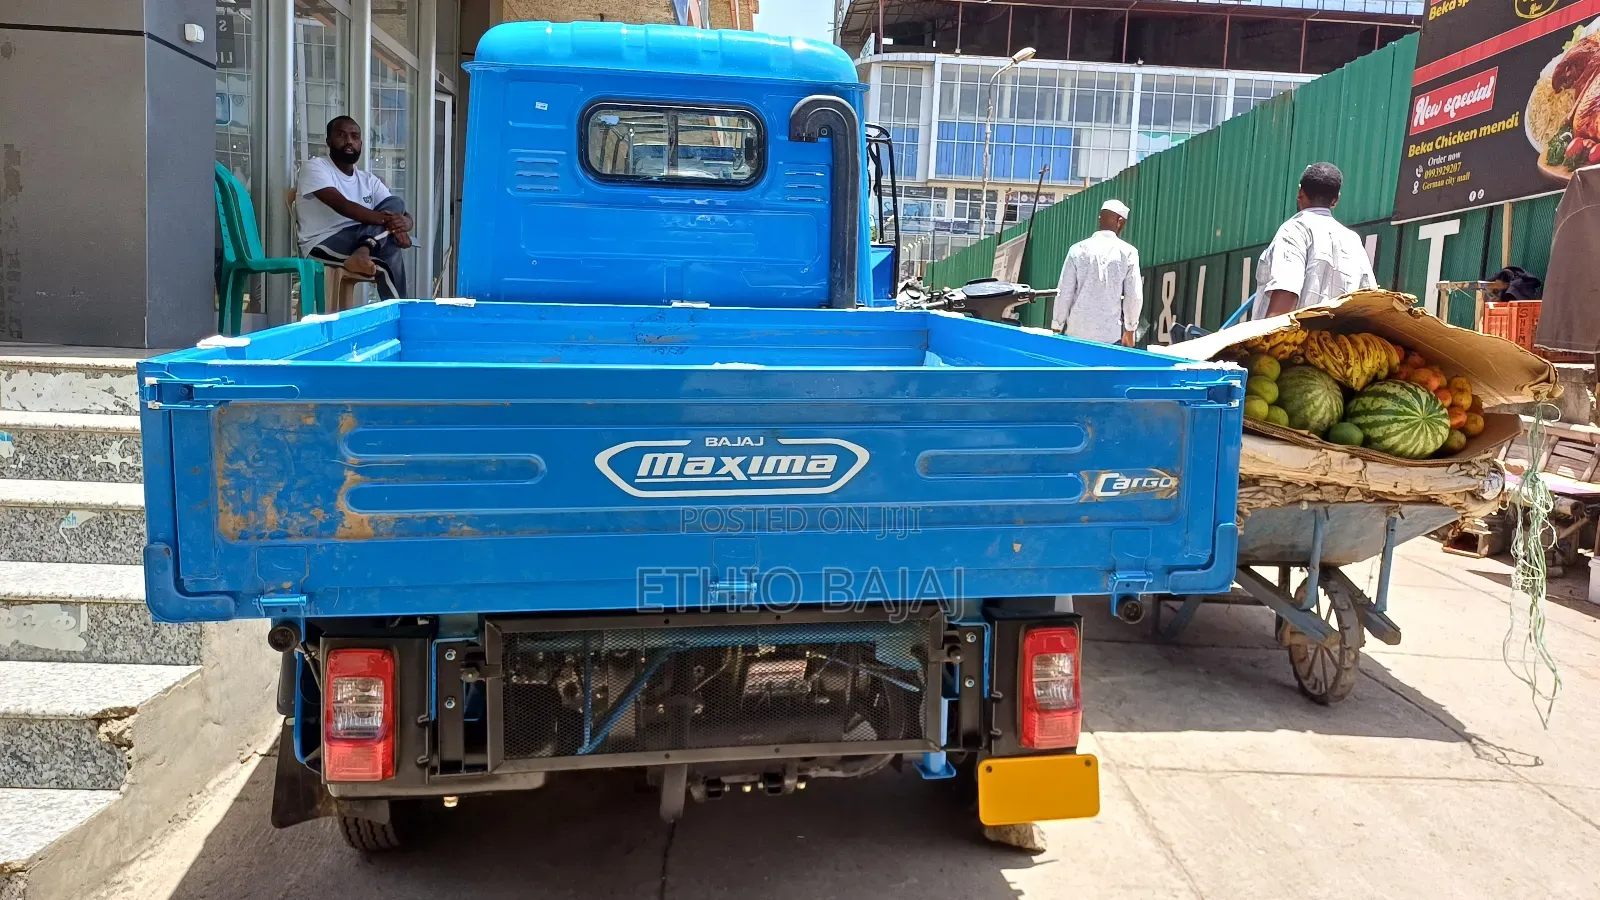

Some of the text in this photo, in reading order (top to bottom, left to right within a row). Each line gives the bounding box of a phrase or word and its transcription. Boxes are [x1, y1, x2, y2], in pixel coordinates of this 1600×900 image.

[1429, 0, 1457, 21] Beka
[1413, 76, 1496, 127] New special
[1408, 111, 1519, 157] Beka Chicken mendi
[1428, 152, 1461, 166] Order now
[1422, 171, 1470, 190] German city mall
[705, 437, 764, 447] BAJAJ
[636, 452, 837, 481] Maxima
